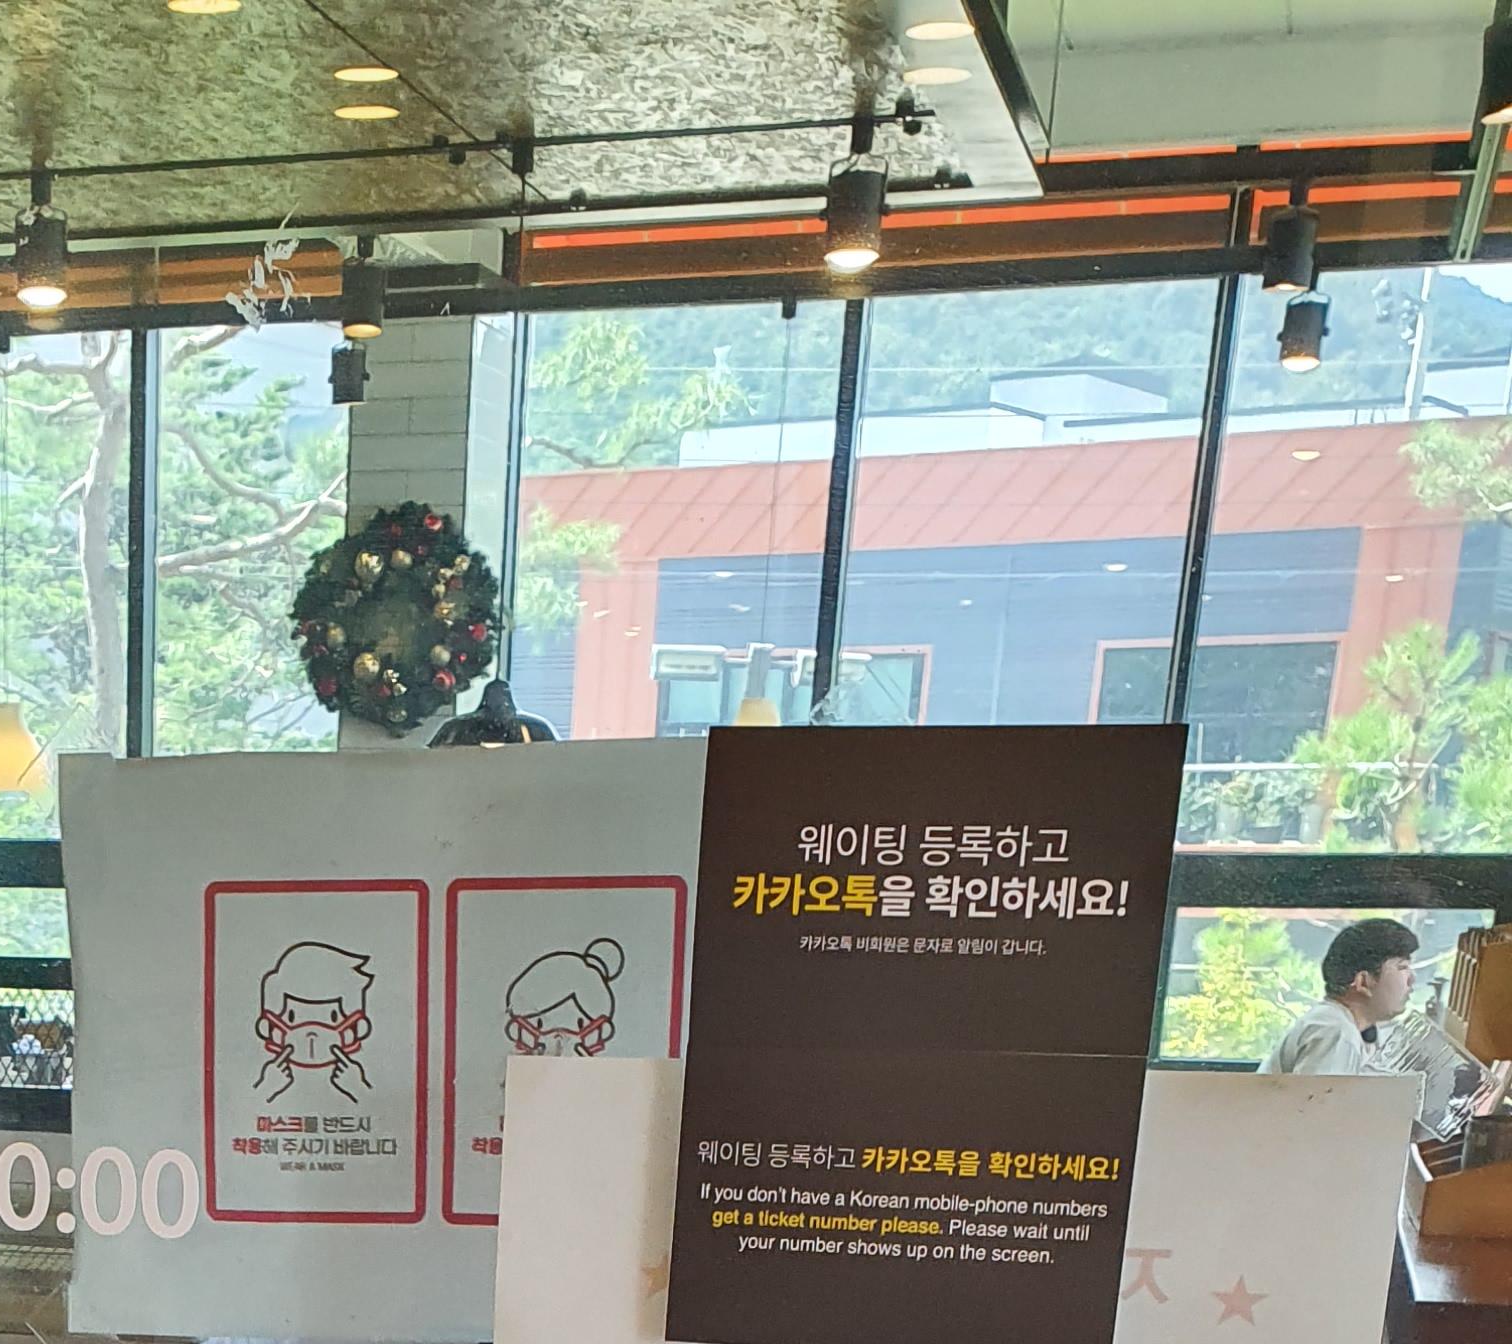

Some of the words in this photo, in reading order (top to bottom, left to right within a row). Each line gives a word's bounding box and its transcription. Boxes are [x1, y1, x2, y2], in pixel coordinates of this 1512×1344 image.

[798, 824, 906, 866] 웨이팅
[918, 825, 1070, 868] 등록하고
[732, 873, 916, 918] 카카오톡을
[924, 875, 1130, 920] 확인하세요!
[799, 935, 853, 952] 카카오톡
[856, 936, 911, 954] 비회원은
[913, 937, 953, 955] 문자로
[957, 938, 998, 955] 알림이
[1001, 939, 1047, 956] 갑니다.
[256, 1116, 318, 1134] 마스크를
[322, 1116, 372, 1134] 반드시
[232, 1137, 278, 1156] 착용해
[282, 1137, 330, 1156] 주시기
[333, 1138, 398, 1156] 바랍니다
[697, 1140, 762, 1168] 웨이팅
[767, 1143, 856, 1170] 등록하고
[861, 1147, 981, 1178] 카카오톡을
[988, 1150, 1120, 1182] 확인하세요!
[700, 1183, 710, 1200] If
[714, 1187, 743, 1207] you
[747, 1184, 787, 1203] don't
[790, 1187, 831, 1205] have
[834, 1194, 845, 1207] a
[850, 1190, 910, 1210] Korean
[914, 1192, 1028, 1219] mobile-phone
[1032, 1198, 1108, 1219] numbers
[712, 1209, 740, 1228] get
[743, 1213, 754, 1226] a
[757, 1210, 805, 1229] ticket
[809, 1212, 877, 1233] number
[880, 1216, 944, 1240] please.
[948, 1219, 1007, 1239] Please
[1013, 1222, 1049, 1241] wait
[1053, 1223, 1089, 1242] until
[738, 1235, 775, 1253] your
[779, 1235, 843, 1255] number
[847, 1238, 902, 1257] shows
[906, 1244, 927, 1261] up
[933, 1246, 955, 1260] on
[959, 1243, 986, 1261] the
[991, 1247, 1055, 1265] screen.
